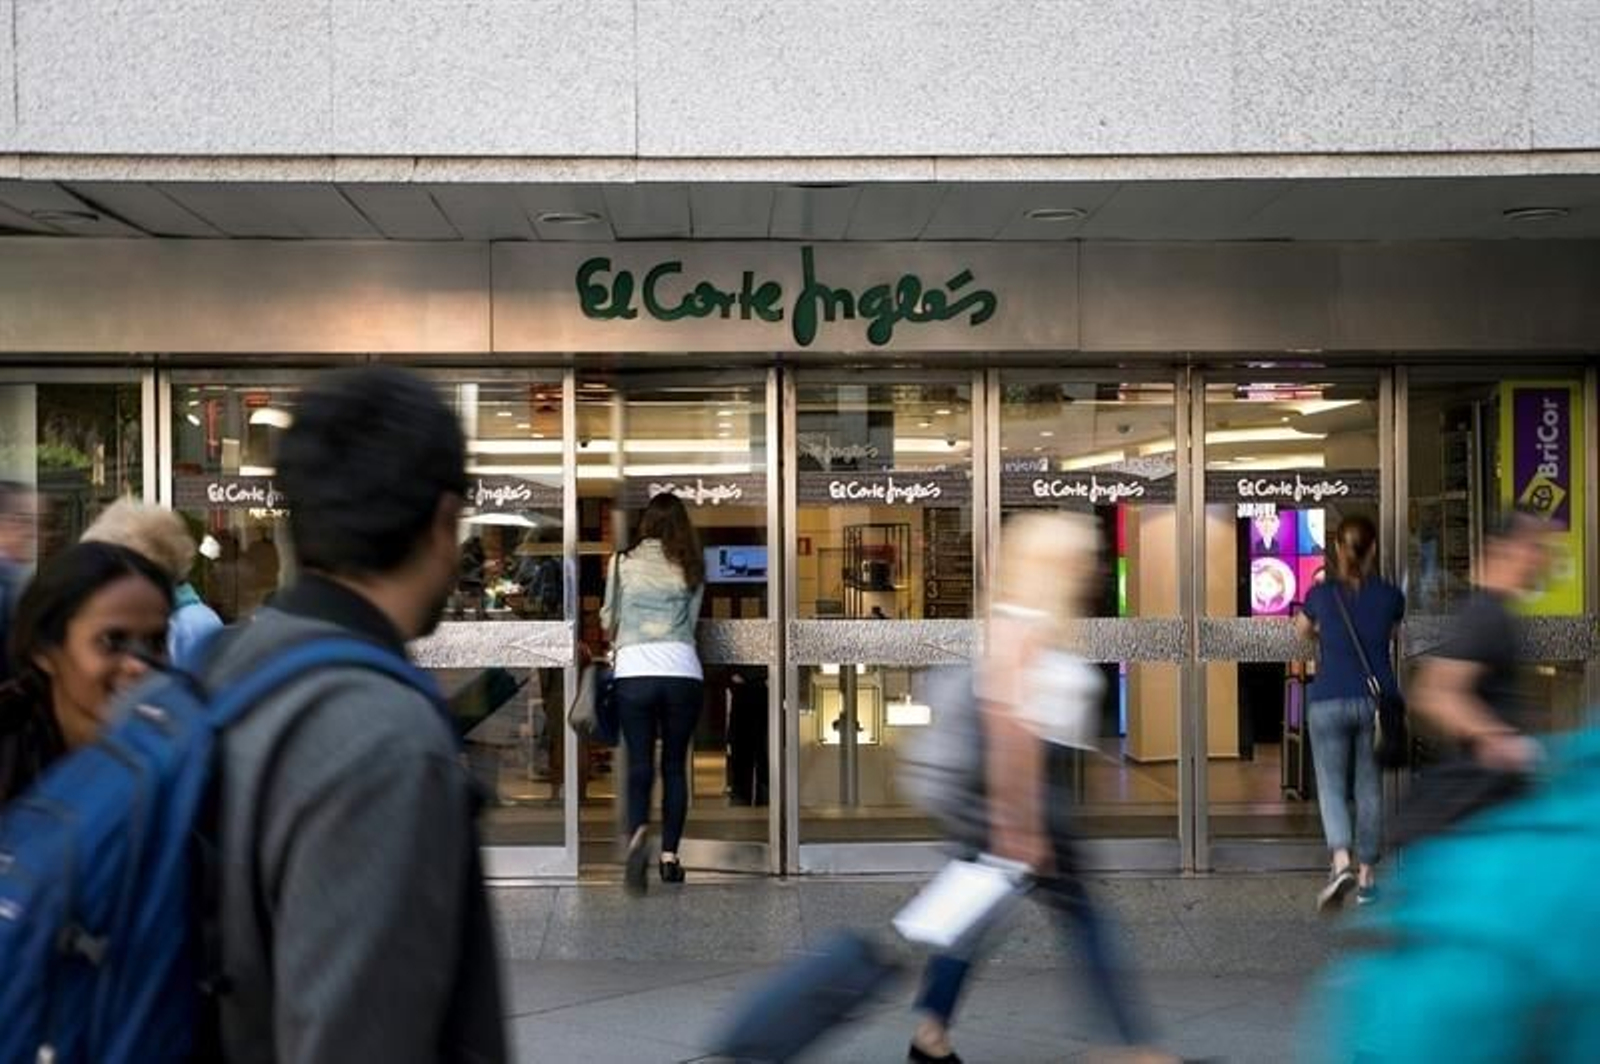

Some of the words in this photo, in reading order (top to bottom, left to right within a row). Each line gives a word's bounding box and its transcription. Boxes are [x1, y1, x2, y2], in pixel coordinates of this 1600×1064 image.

[576, 257, 637, 320] El
[642, 261, 783, 321] Corte
[792, 245, 997, 346] Inglés
[1536, 397, 1559, 478] BriCor
[207, 483, 225, 502] El
[225, 483, 265, 502] Corte
[475, 479, 532, 506] Inglés
[829, 481, 846, 499] El
[847, 481, 885, 499] Corte
[885, 477, 942, 504] Inglés
[1032, 480, 1050, 497] El
[1050, 480, 1088, 497] Corte
[1088, 475, 1145, 502] Inglés
[1237, 479, 1254, 496] El
[1255, 479, 1293, 496] Corte
[1293, 474, 1349, 502] Inglés
